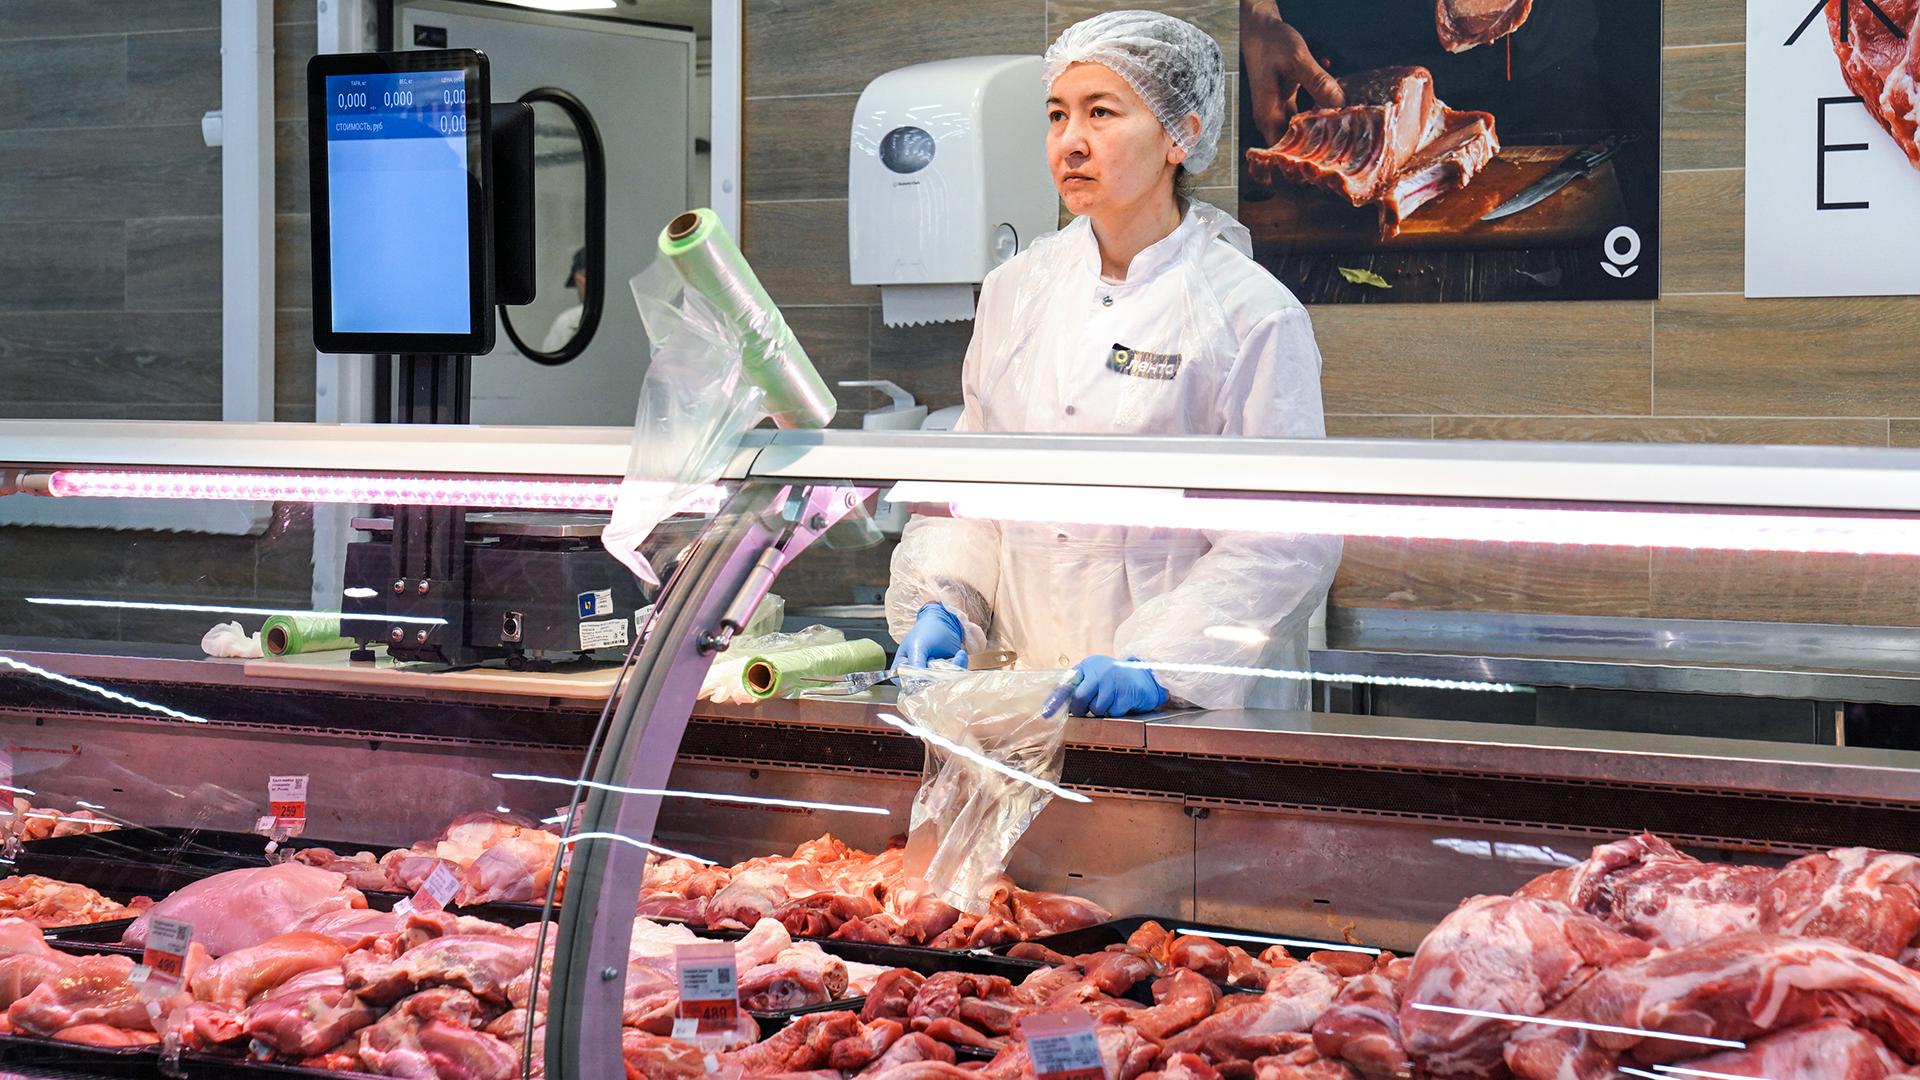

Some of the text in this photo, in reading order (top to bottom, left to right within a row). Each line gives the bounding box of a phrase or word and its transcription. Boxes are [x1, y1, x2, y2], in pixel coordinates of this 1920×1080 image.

[338, 92, 367, 110] 0,000
[384, 91, 413, 109] 0,000
[336, 121, 383, 133] СТОИМОСТЬ, руб
[281, 805, 297, 818] 259
[703, 1006, 728, 1021] 489
